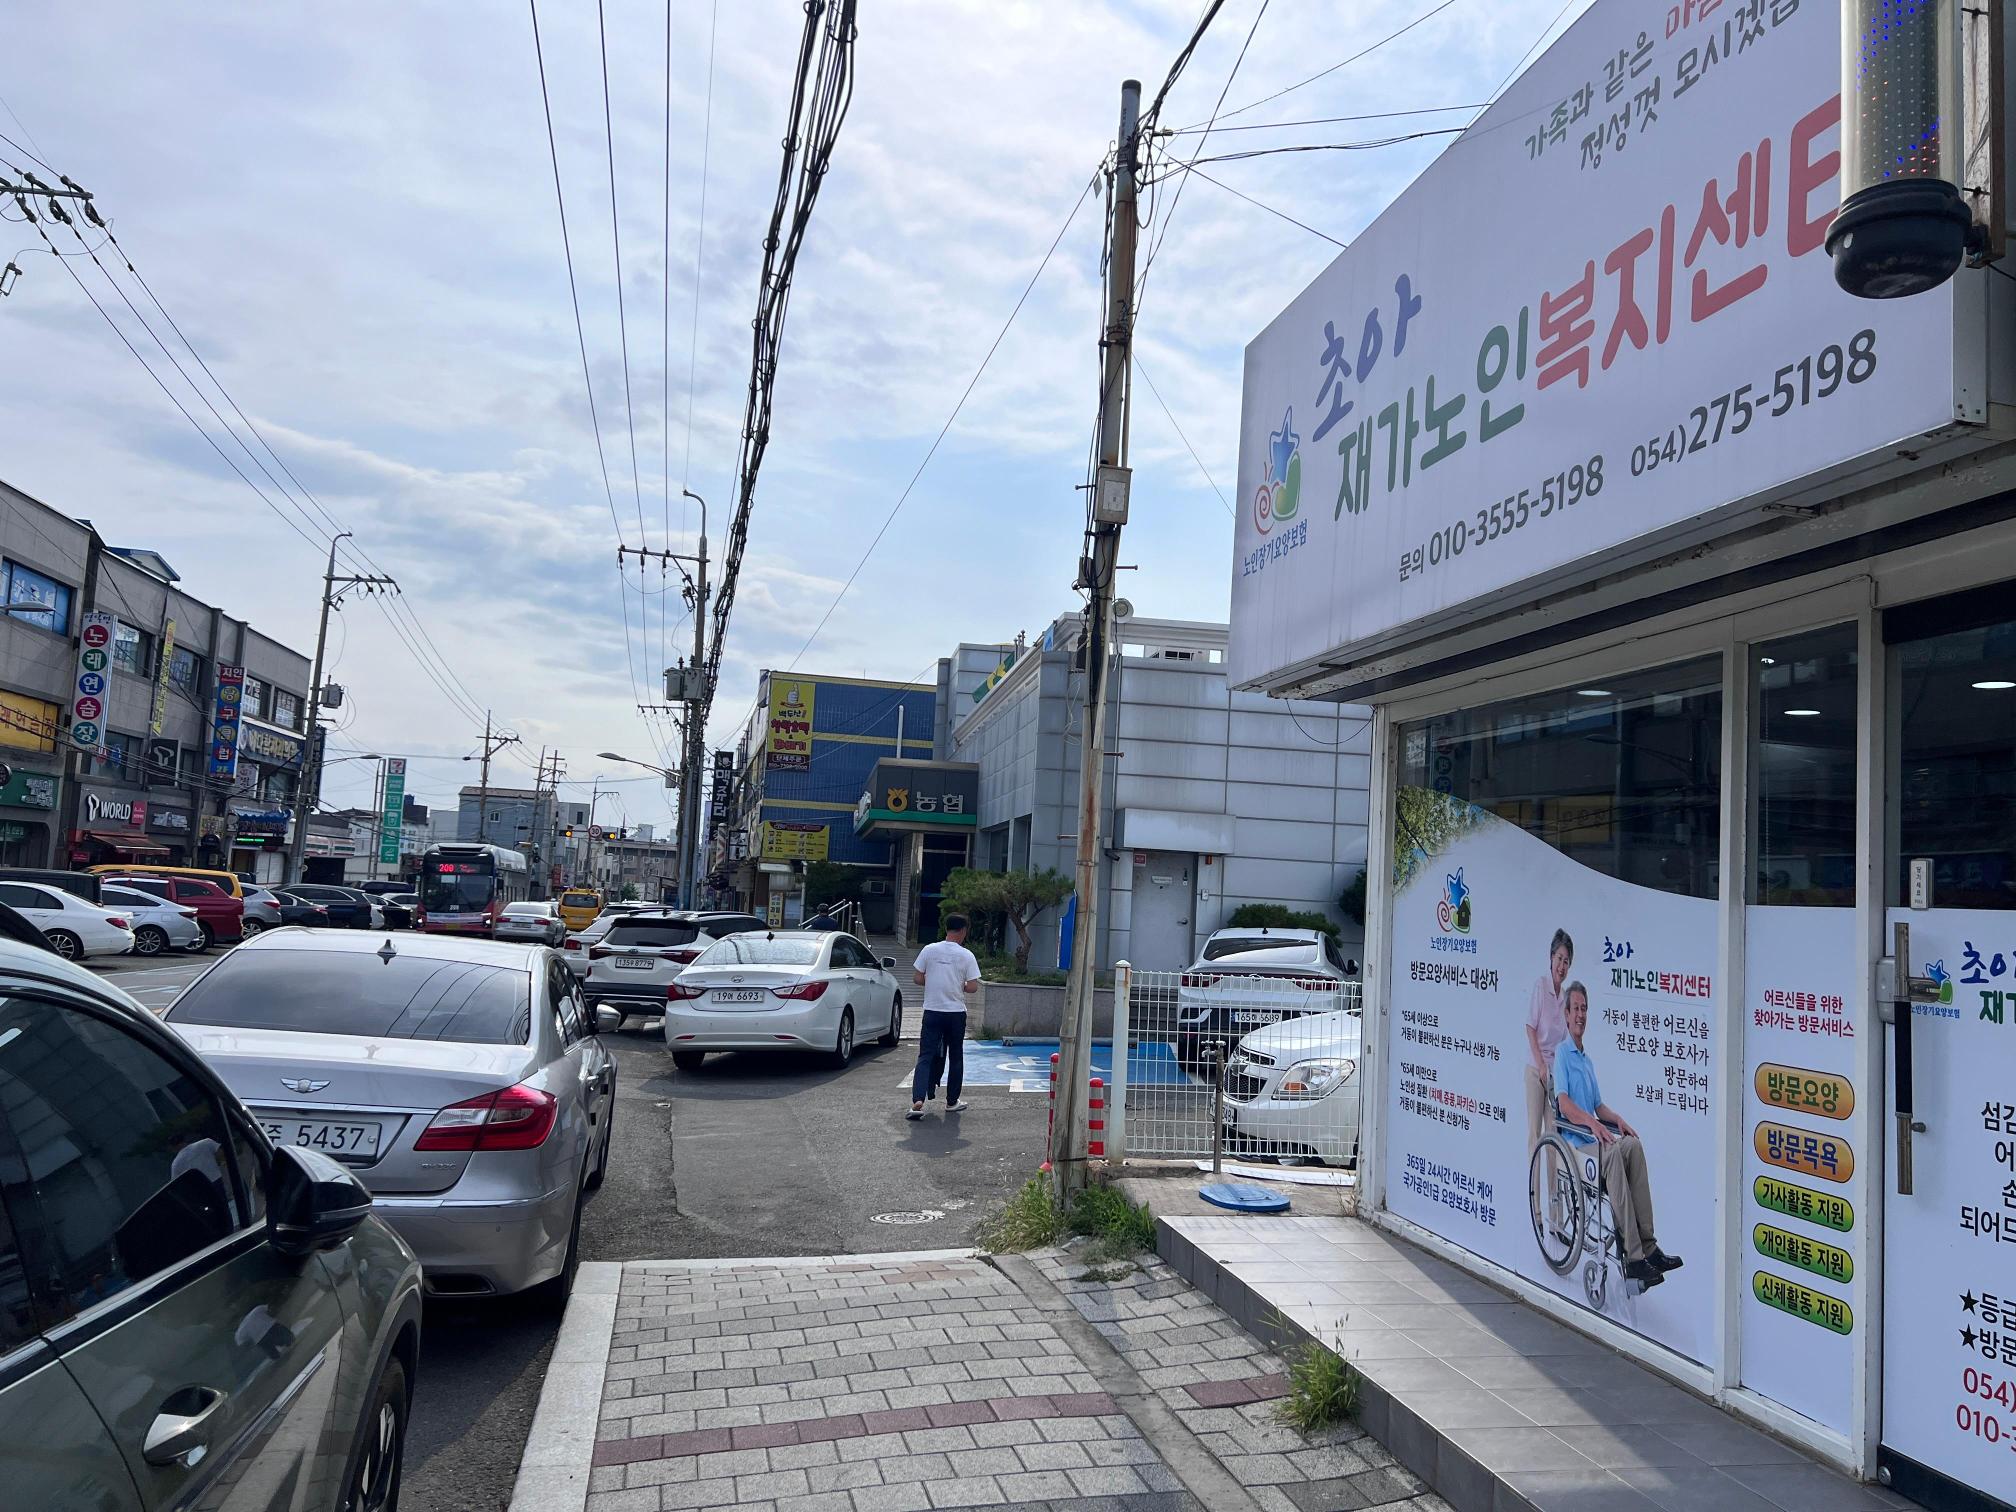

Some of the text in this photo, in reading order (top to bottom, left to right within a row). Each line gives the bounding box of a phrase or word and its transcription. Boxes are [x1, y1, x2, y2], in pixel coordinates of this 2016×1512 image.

[1525, 81, 1594, 160] 가족과
[1603, 31, 1655, 103] 같은
[1580, 76, 1660, 171] 정성껏
[1312, 273, 1421, 442] 초아
[1399, 328, 1877, 582] 문의 010-3555-5198 054)275-5198
[1243, 518, 1308, 577] 노인장기요양보험
[77, 628, 105, 742] 노래연습장
[222, 666, 243, 678] 지인
[100, 801, 131, 820] WORLD
[915, 791, 964, 814] 농협
[1431, 937, 1477, 954] 노인장기요양보험
[1602, 936, 1634, 963] 초아
[1411, 960, 1498, 992] 방문요양서비스 대상자
[1611, 968, 1711, 998] 재가노인복지센터
[737, 991, 759, 1001] 6693
[1764, 989, 1843, 1015] 어르신들을 위한
[1417, 1012, 1439, 1028] 이상으로
[1601, 1008, 1709, 1040] 거동이 불편한 어르신을
[1754, 1009, 1855, 1038] 찾아가는 방문서비스
[1401, 1027, 1417, 1042] 거동이
[1441, 1035, 1453, 1050] 분은
[1454, 1038, 1472, 1055] 누구나
[1473, 1042, 1486, 1057] 신청
[1487, 1045, 1500, 1060] 가능
[1616, 1032, 1709, 1067] 전문요양 보호사가
[1416, 1065, 1437, 1081] 미만으로
[1664, 1066, 1708, 1094] 방문하여
[1400, 1079, 1415, 1095] 노인성
[1493, 1106, 1506, 1123] 인해
[1400, 1096, 1415, 1113] 거동이
[1635, 1084, 1709, 1116] 보살펴 드립니다
[1768, 1072, 1839, 1113] 방문요양
[296, 1124, 365, 1151] 5437
[1767, 1129, 1838, 1175] 방문목욕
[1407, 1153, 1493, 1203] 365일 24시간 어르신 케어
[1403, 1171, 1497, 1227] 국가공인1급 요양보호사 방문
[1762, 1182, 1844, 1226] 가사활동 지원
[1761, 1229, 1844, 1278] 개인활동 지원
[1761, 1276, 1844, 1329] 신체활동 지원
